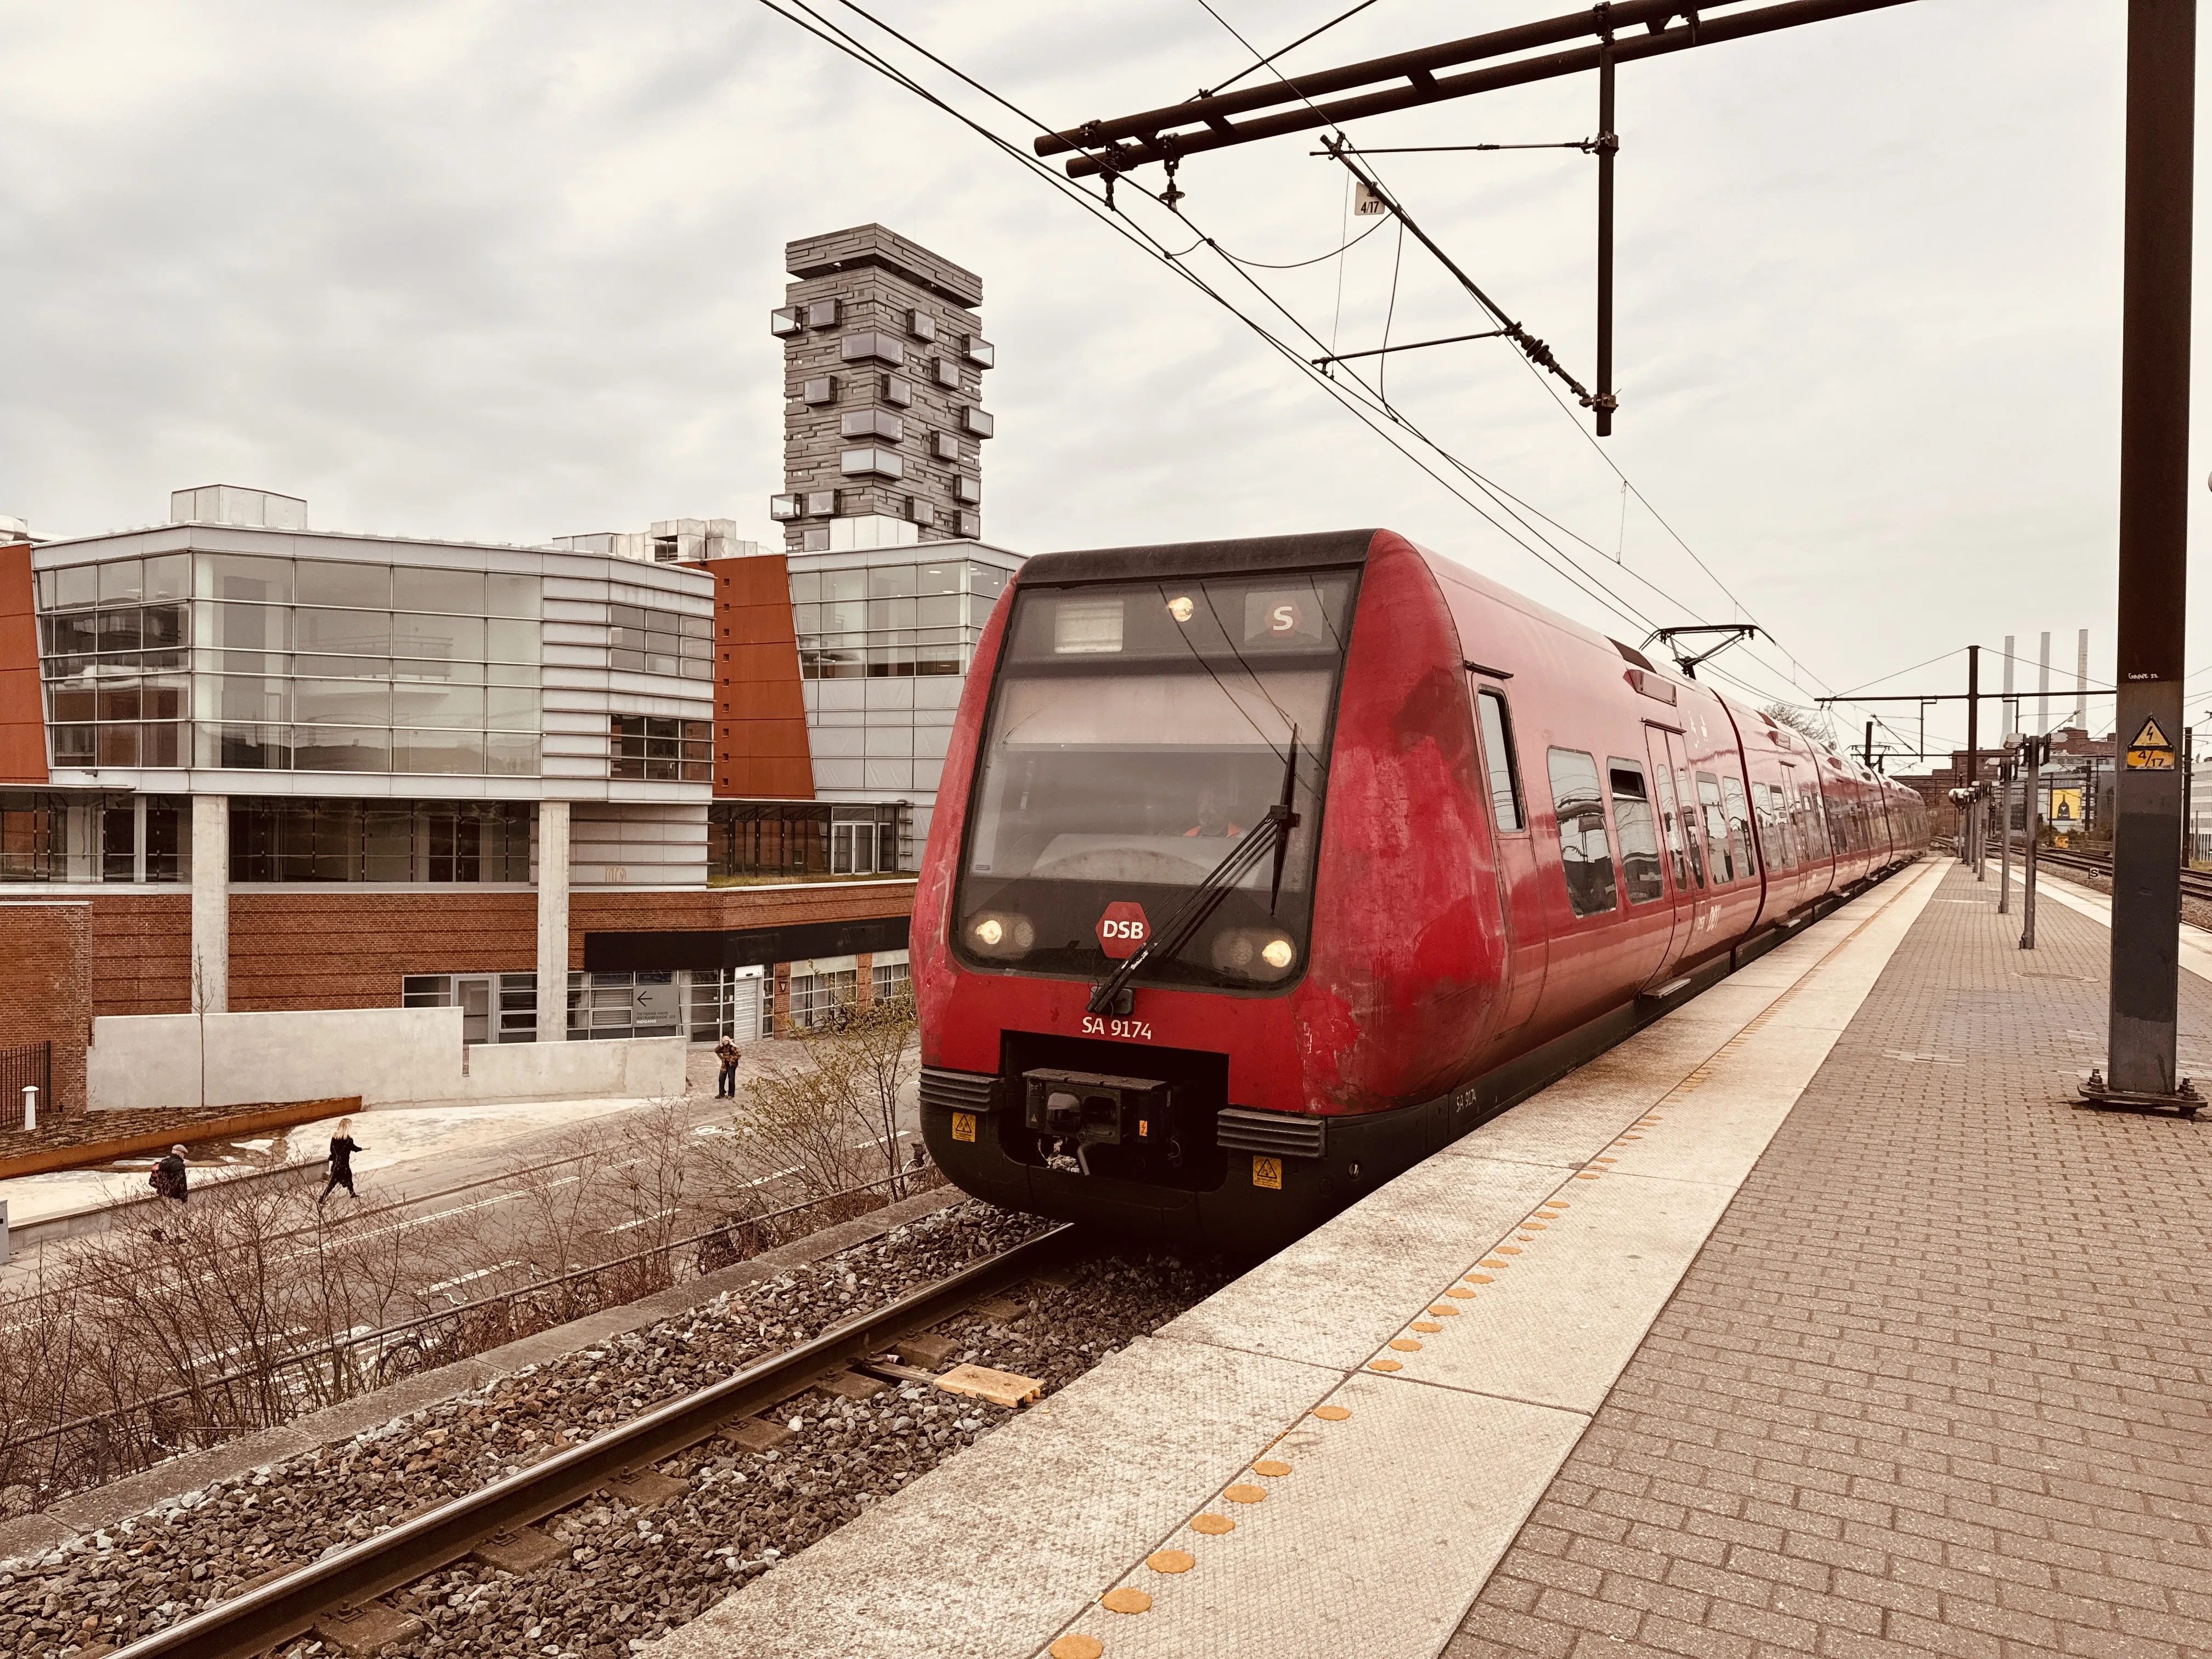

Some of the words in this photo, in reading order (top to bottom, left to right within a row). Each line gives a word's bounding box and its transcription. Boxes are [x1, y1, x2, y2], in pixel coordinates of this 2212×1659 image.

[1361, 201, 1379, 213] 4/17
[1273, 606, 1293, 630] S
[2138, 751, 2164, 768] 4/17
[2090, 869, 2098, 877] S
[1103, 920, 1143, 939] DSB
[1082, 1017, 1105, 1035] SA
[1111, 1019, 1152, 1040] 9174
[1456, 1094, 1464, 1113] SA
[1465, 1088, 1477, 1107] 9174
